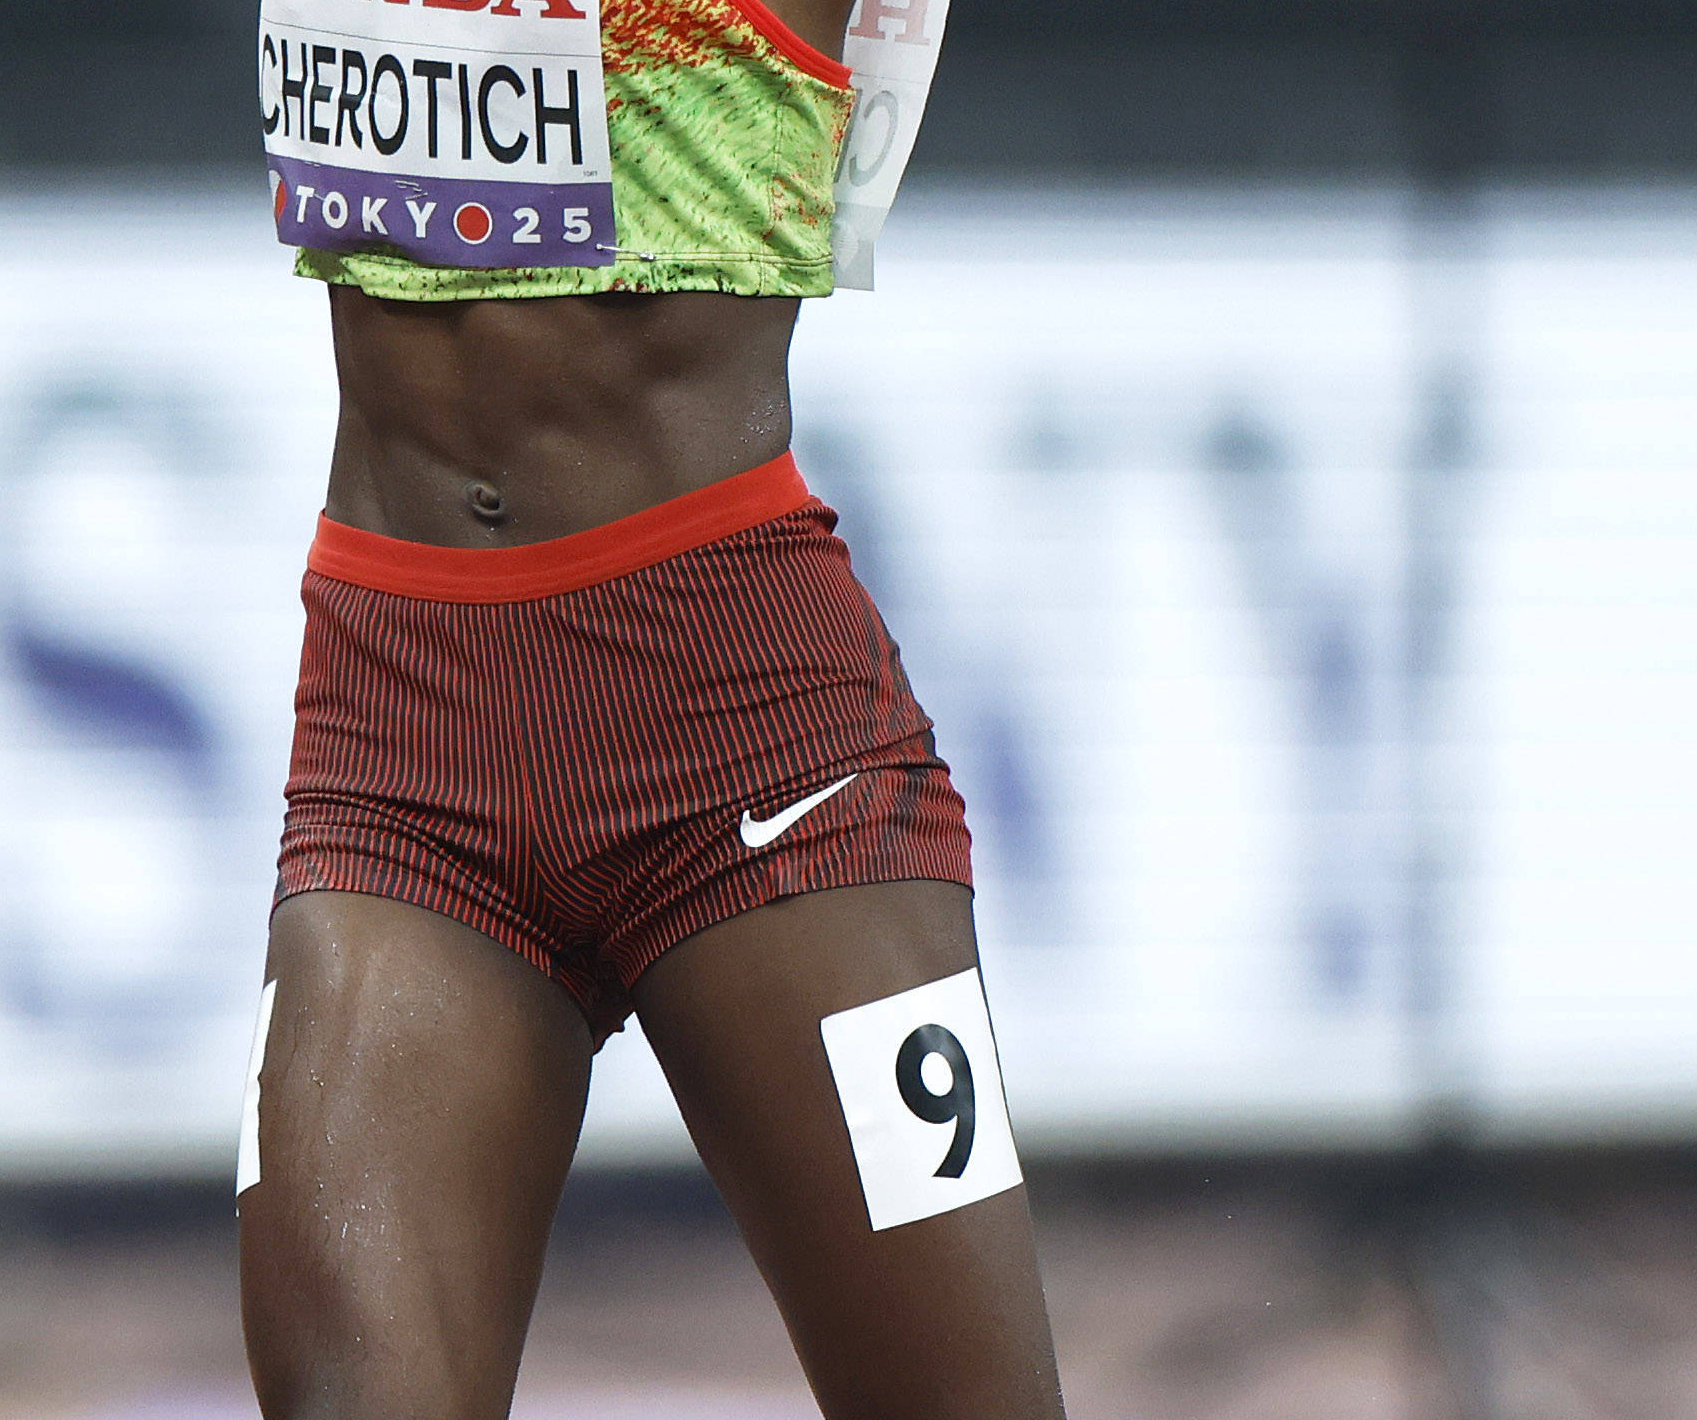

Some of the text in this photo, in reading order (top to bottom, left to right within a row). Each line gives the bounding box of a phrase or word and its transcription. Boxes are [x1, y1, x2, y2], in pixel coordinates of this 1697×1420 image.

[261, 33, 583, 166] CHEROTICH
[512, 206, 593, 244] 25
[895, 1023, 976, 1180] 9
